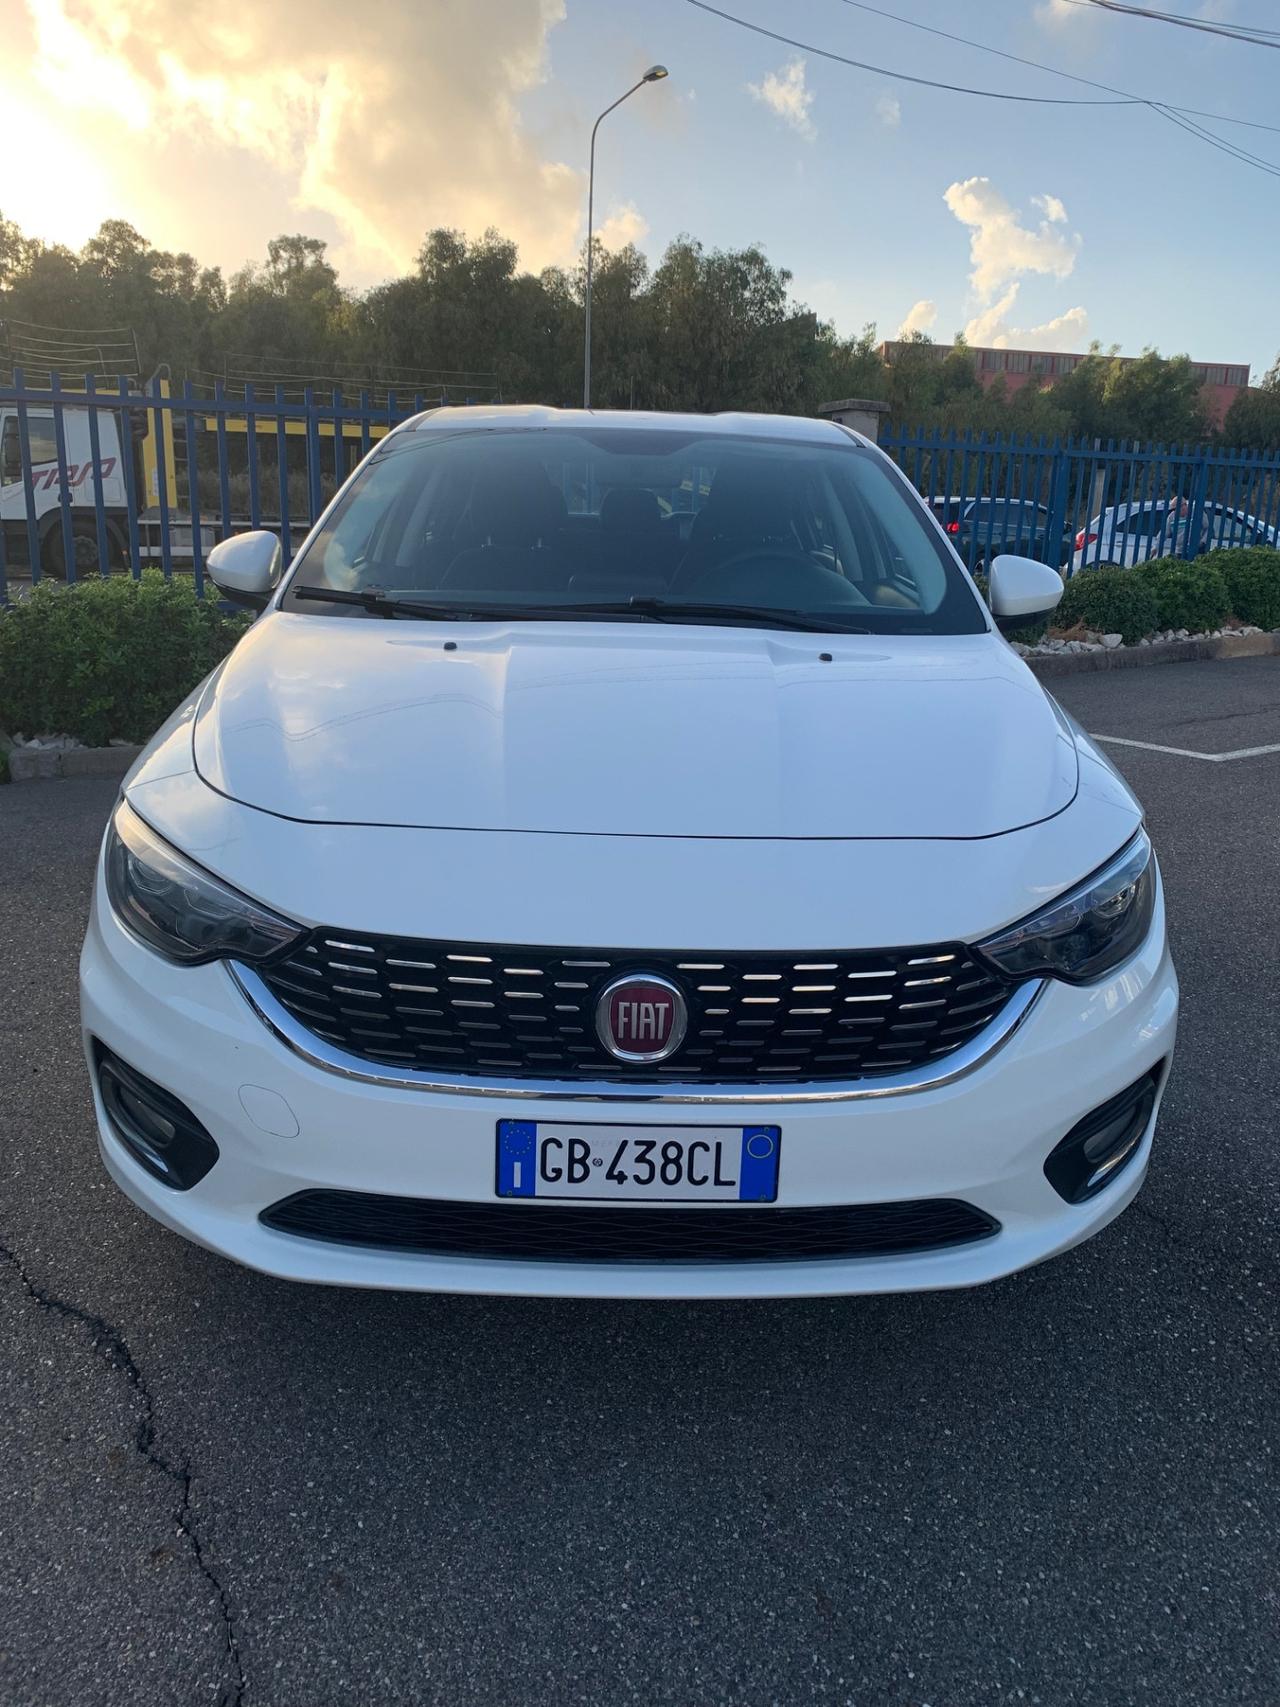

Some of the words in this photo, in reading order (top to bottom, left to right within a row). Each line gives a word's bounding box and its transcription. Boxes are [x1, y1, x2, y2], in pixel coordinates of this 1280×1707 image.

[618, 1001, 669, 1040] FIAT
[540, 1137, 591, 1184] GB
[605, 1139, 736, 1187] 438CL
